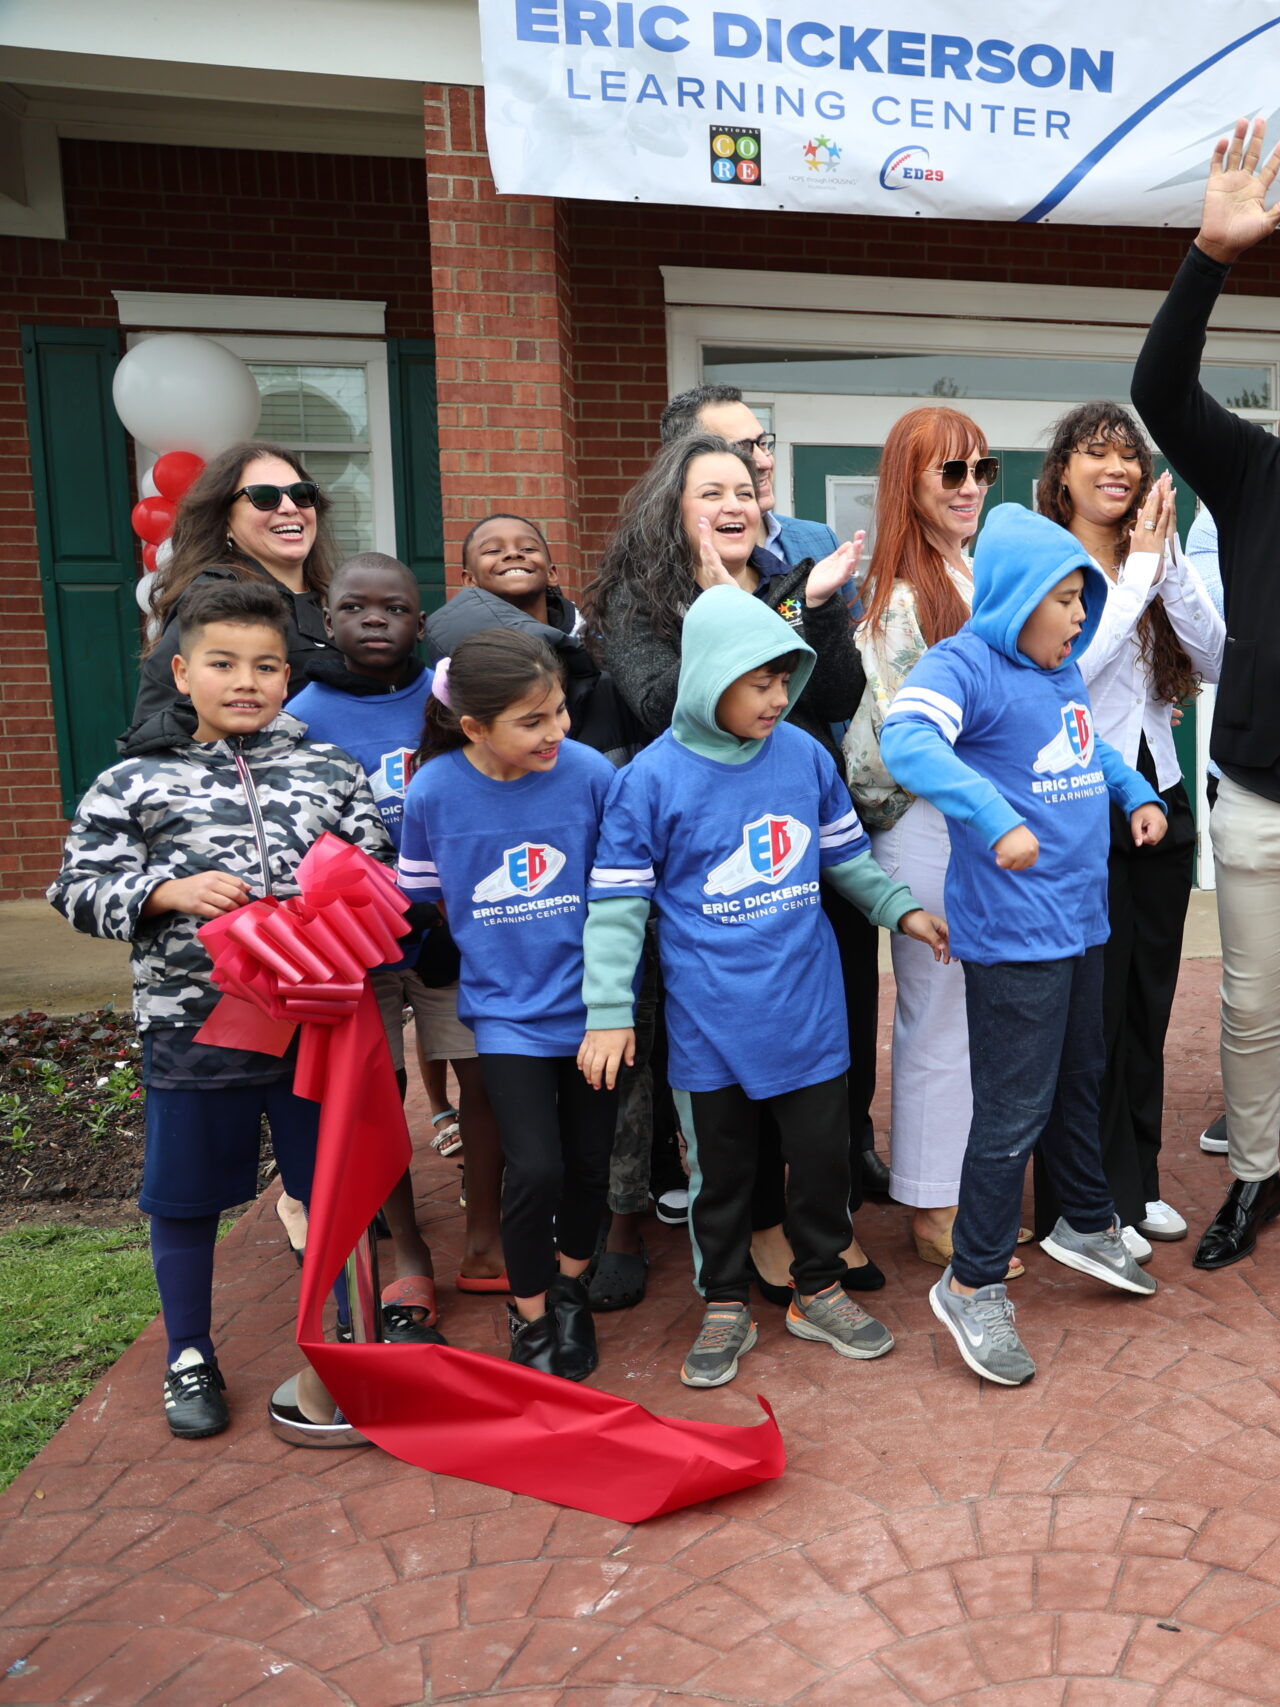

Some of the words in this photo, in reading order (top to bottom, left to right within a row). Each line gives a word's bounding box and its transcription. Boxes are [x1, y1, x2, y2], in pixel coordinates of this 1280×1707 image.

[515, 0, 690, 53] ERIC
[713, 11, 1114, 93] DICKERSON
[567, 68, 846, 121] LEARNING
[872, 95, 1071, 140] CENTER
[711, 126, 759, 135] NATIONAL
[903, 167, 944, 182] ED29
[1031, 778, 1068, 793] ERIC
[1044, 790, 1093, 804] LEARNING
[472, 906, 504, 919] ERIC
[505, 894, 580, 915] DICKERSON
[702, 900, 741, 915] ERIC
[744, 881, 820, 909] DICKERSO
[714, 906, 778, 924] EARNING
[782, 895, 820, 911] CENTE
[483, 913, 533, 927] LEARNING
[536, 905, 577, 919] CENTER
